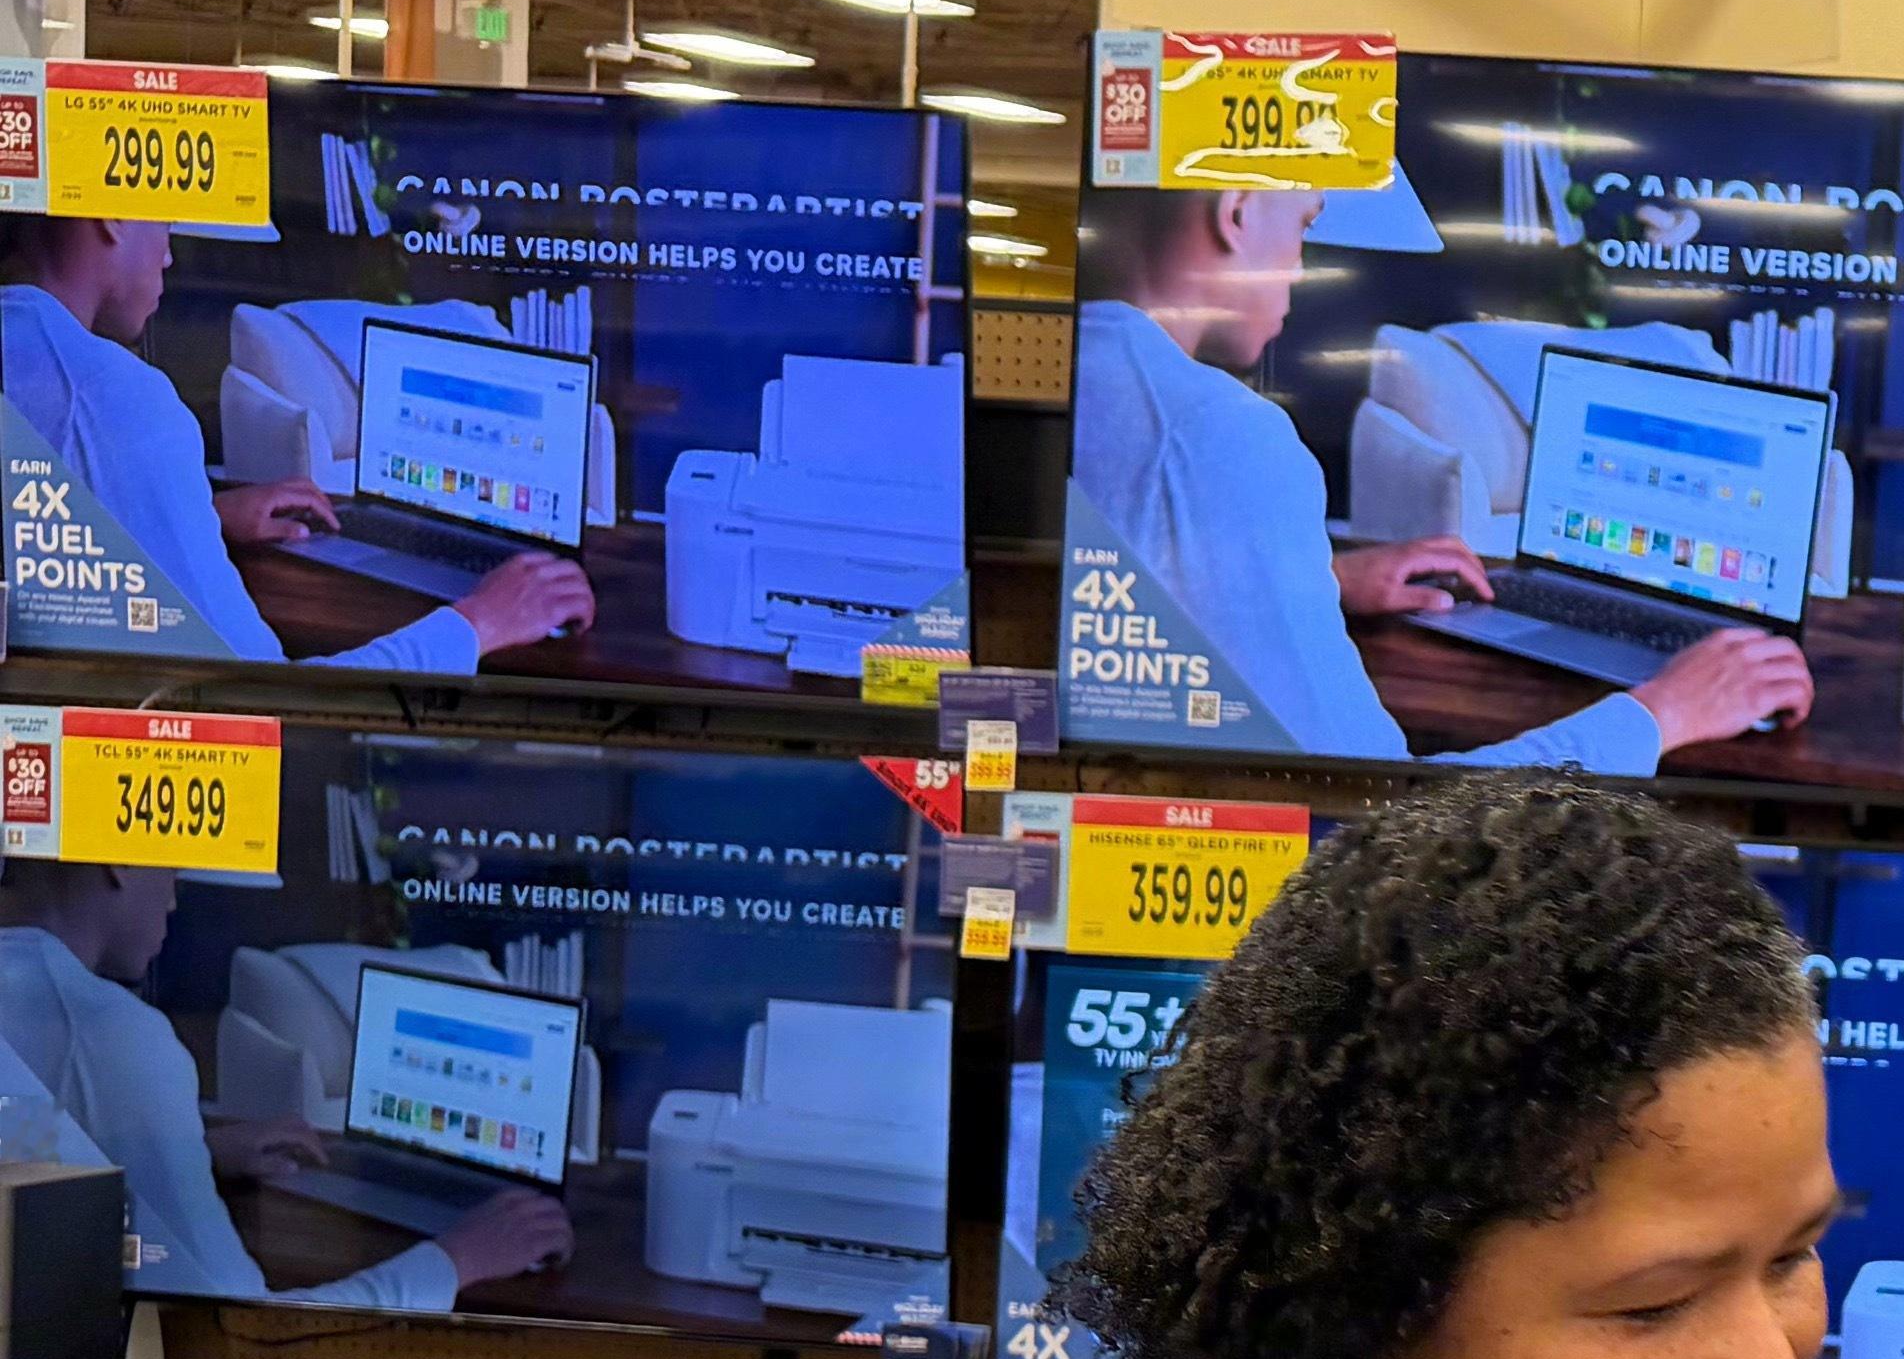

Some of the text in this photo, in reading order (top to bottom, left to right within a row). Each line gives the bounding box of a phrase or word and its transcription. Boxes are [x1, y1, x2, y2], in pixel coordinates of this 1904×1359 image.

[134, 71, 178, 90] SALE
[1237, 68, 1256, 80] 4K
[1262, 68, 1287, 80] UH
[1359, 69, 1378, 81] TV
[1106, 83, 1146, 103] $30
[65, 97, 251, 118] LG 55" 4K UHD SMART TV
[1105, 104, 1147, 123] OFF
[104, 126, 215, 192] 299.99
[403, 230, 925, 281] ONLINE VERSION HELPS YOU CREATE
[1599, 237, 1730, 276] ONLINE
[1741, 244, 1898, 285] VERSION
[11, 460, 51, 475] EARN
[12, 479, 70, 520] 4X
[14, 521, 104, 556] FUEL
[1074, 548, 1119, 567] EARN
[16, 556, 146, 594] POINTS
[1072, 569, 1137, 612] 4X
[1071, 611, 1168, 649] FUEL
[1070, 647, 1210, 688] POINTS
[149, 719, 192, 739] SALE
[95, 744, 250, 765] TCL 55" 4K SMART TV
[9, 759, 46, 779] $30
[915, 760, 960, 790] 55"
[8, 778, 46, 796] OFF
[116, 773, 226, 838] 349.99
[1165, 805, 1213, 827] SALE
[1089, 831, 1153, 846] HISENSE
[1233, 837, 1267, 853] FIRE
[1271, 839, 1292, 856] TV
[403, 877, 907, 931] ONLINE VERSION HELPS YOU CREATE
[1128, 862, 1248, 927] 359.99
[1094, 1048, 1117, 1068] TV
[1007, 1302, 1042, 1320] EA
